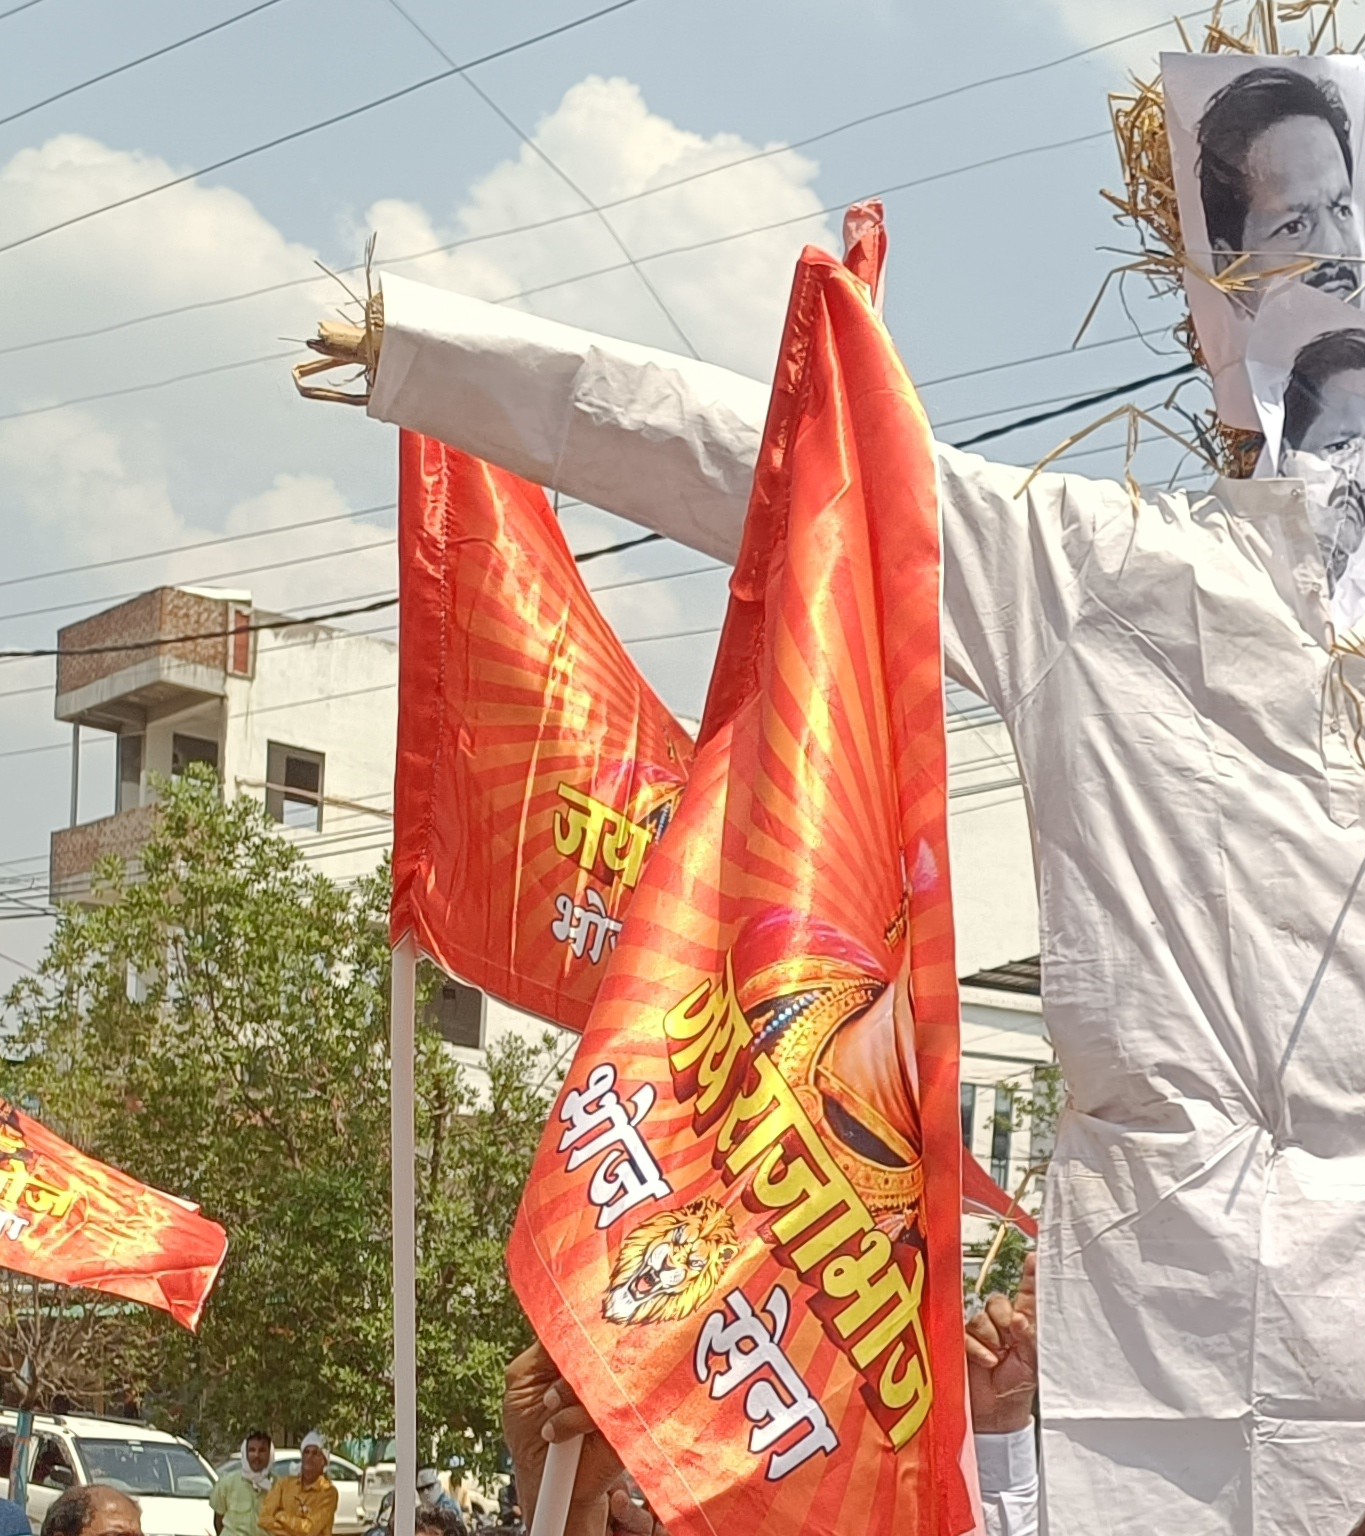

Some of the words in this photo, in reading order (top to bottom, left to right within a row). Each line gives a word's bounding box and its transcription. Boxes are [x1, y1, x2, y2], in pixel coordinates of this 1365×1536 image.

[553, 781, 654, 888] जय
[662, 946, 757, 1120] जय
[558, 1062, 671, 1230] भोज
[694, 1284, 841, 1482] सेना
